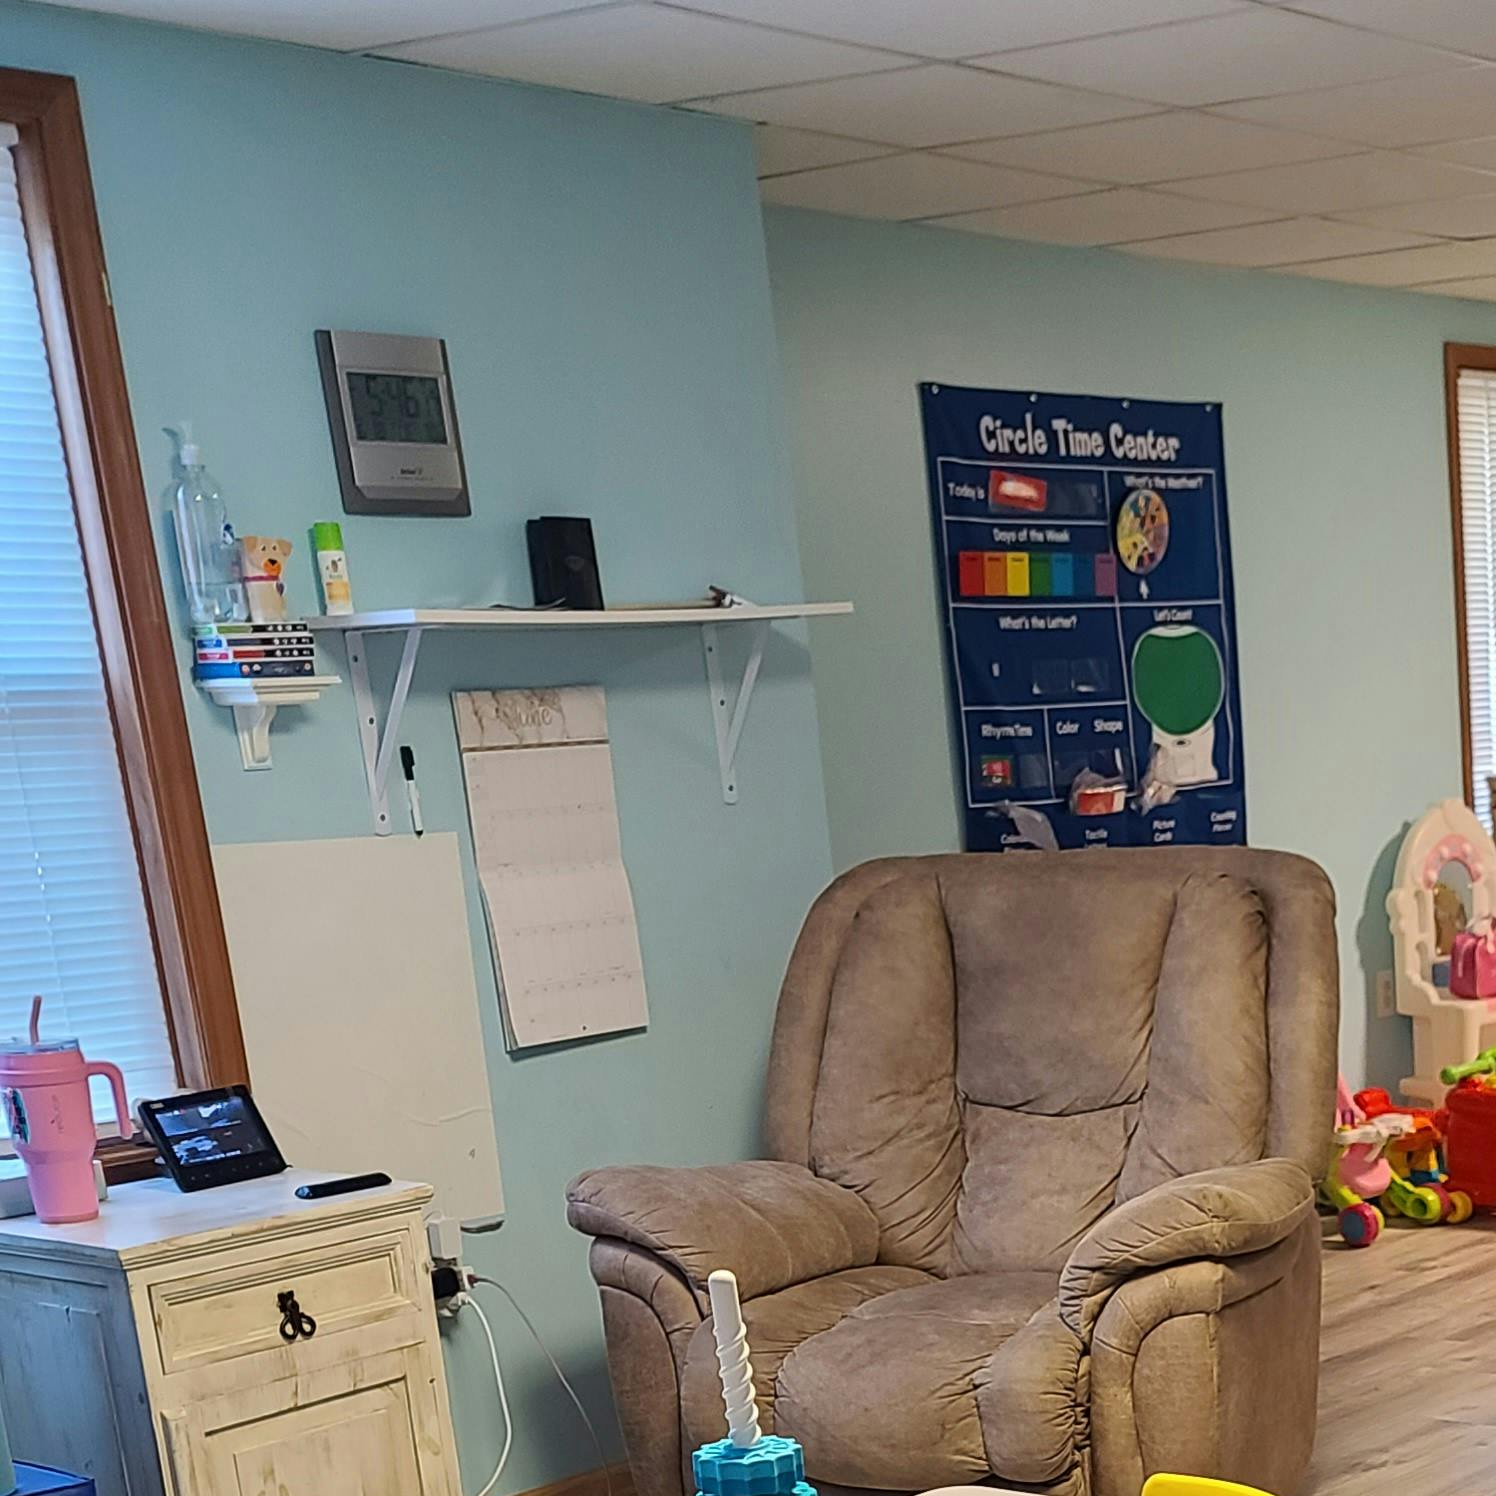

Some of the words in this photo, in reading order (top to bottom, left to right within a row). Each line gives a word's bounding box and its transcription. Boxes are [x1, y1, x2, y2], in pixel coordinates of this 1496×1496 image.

[979, 412, 1049, 455] Circle
[1051, 418, 1105, 457] Time
[1109, 422, 1180, 462] Center
[947, 482, 975, 501] Today
[993, 528, 1017, 544] Days
[1018, 529, 1027, 542] of
[1029, 530, 1044, 542] the
[1045, 530, 1071, 543] Week
[998, 616, 1030, 630] What's
[1056, 720, 1080, 735] Color
[1093, 718, 1123, 734] Shape
